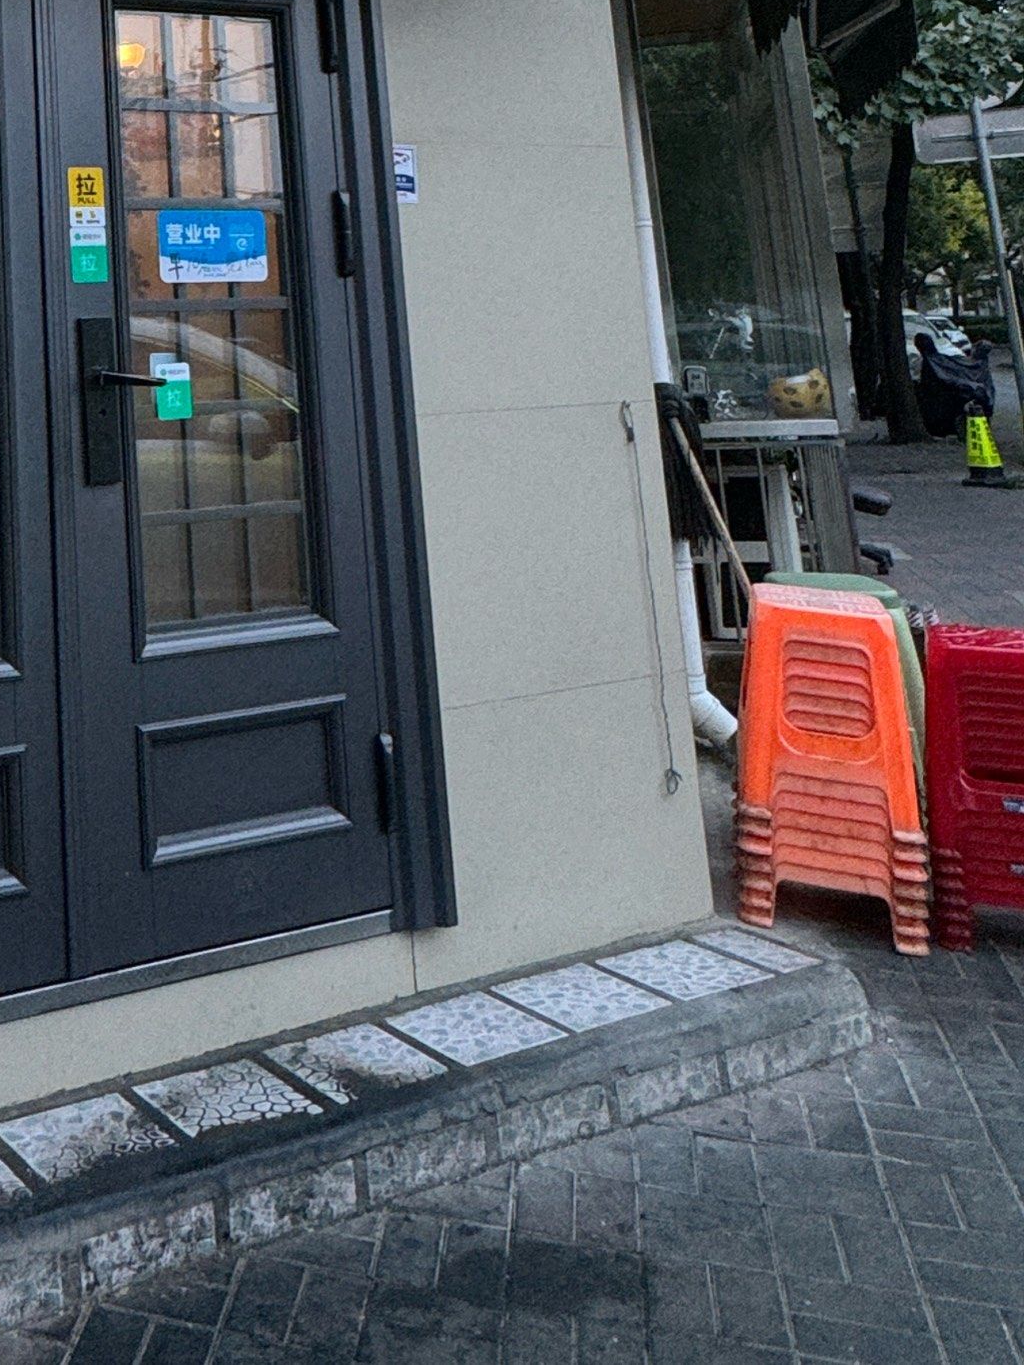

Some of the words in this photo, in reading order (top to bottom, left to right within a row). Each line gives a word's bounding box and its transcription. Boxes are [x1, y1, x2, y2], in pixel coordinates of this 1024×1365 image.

[75, 172, 97, 196] 拉
[165, 223, 221, 245] 营业中
